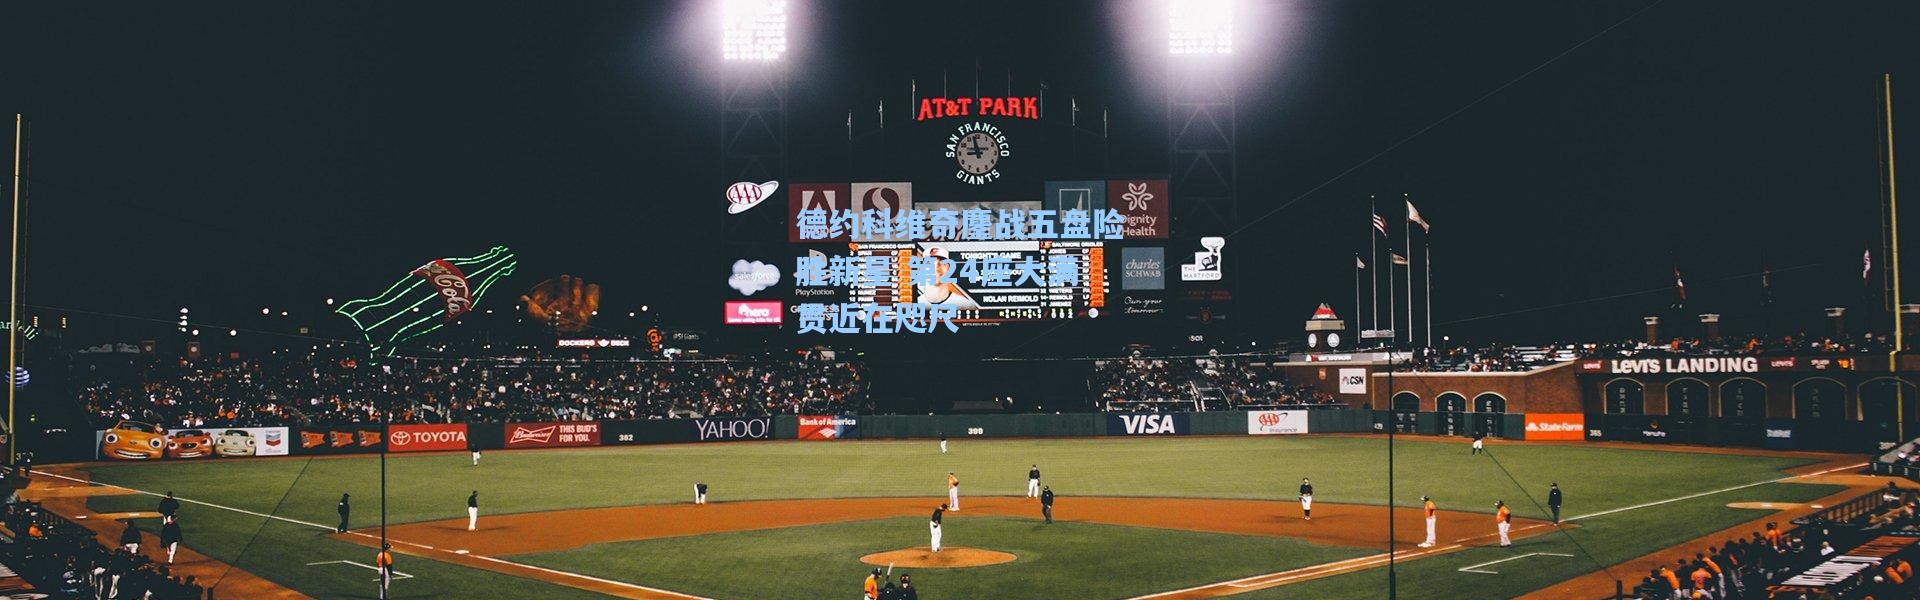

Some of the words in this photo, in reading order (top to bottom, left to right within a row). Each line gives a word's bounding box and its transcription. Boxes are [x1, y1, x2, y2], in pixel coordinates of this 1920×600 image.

[918, 98, 972, 121] AT&T
[979, 97, 1039, 120] PARK
[946, 134, 960, 158] SAN
[958, 121, 1010, 157] FRANCISCO
[956, 169, 1000, 185] GIANTS
[730, 184, 761, 203] AAA
[1122, 226, 1156, 236] Health
[1126, 259, 1160, 269] charles
[1125, 270, 1161, 278] SCHWAB
[435, 274, 471, 315] Cola
[795, 289, 835, 297] PlayStation
[1666, 357, 1758, 373] LANDING
[1350, 376, 1364, 384] CSN
[1119, 415, 1175, 434] VISA
[1259, 413, 1279, 426] AAA
[515, 430, 551, 438] Budweiser
[560, 425, 575, 433] THIS
[577, 424, 597, 432] BUD'S
[696, 418, 770, 440] YAHOO!
[413, 431, 466, 443] TOYOTA
[560, 434, 573, 442] FOR
